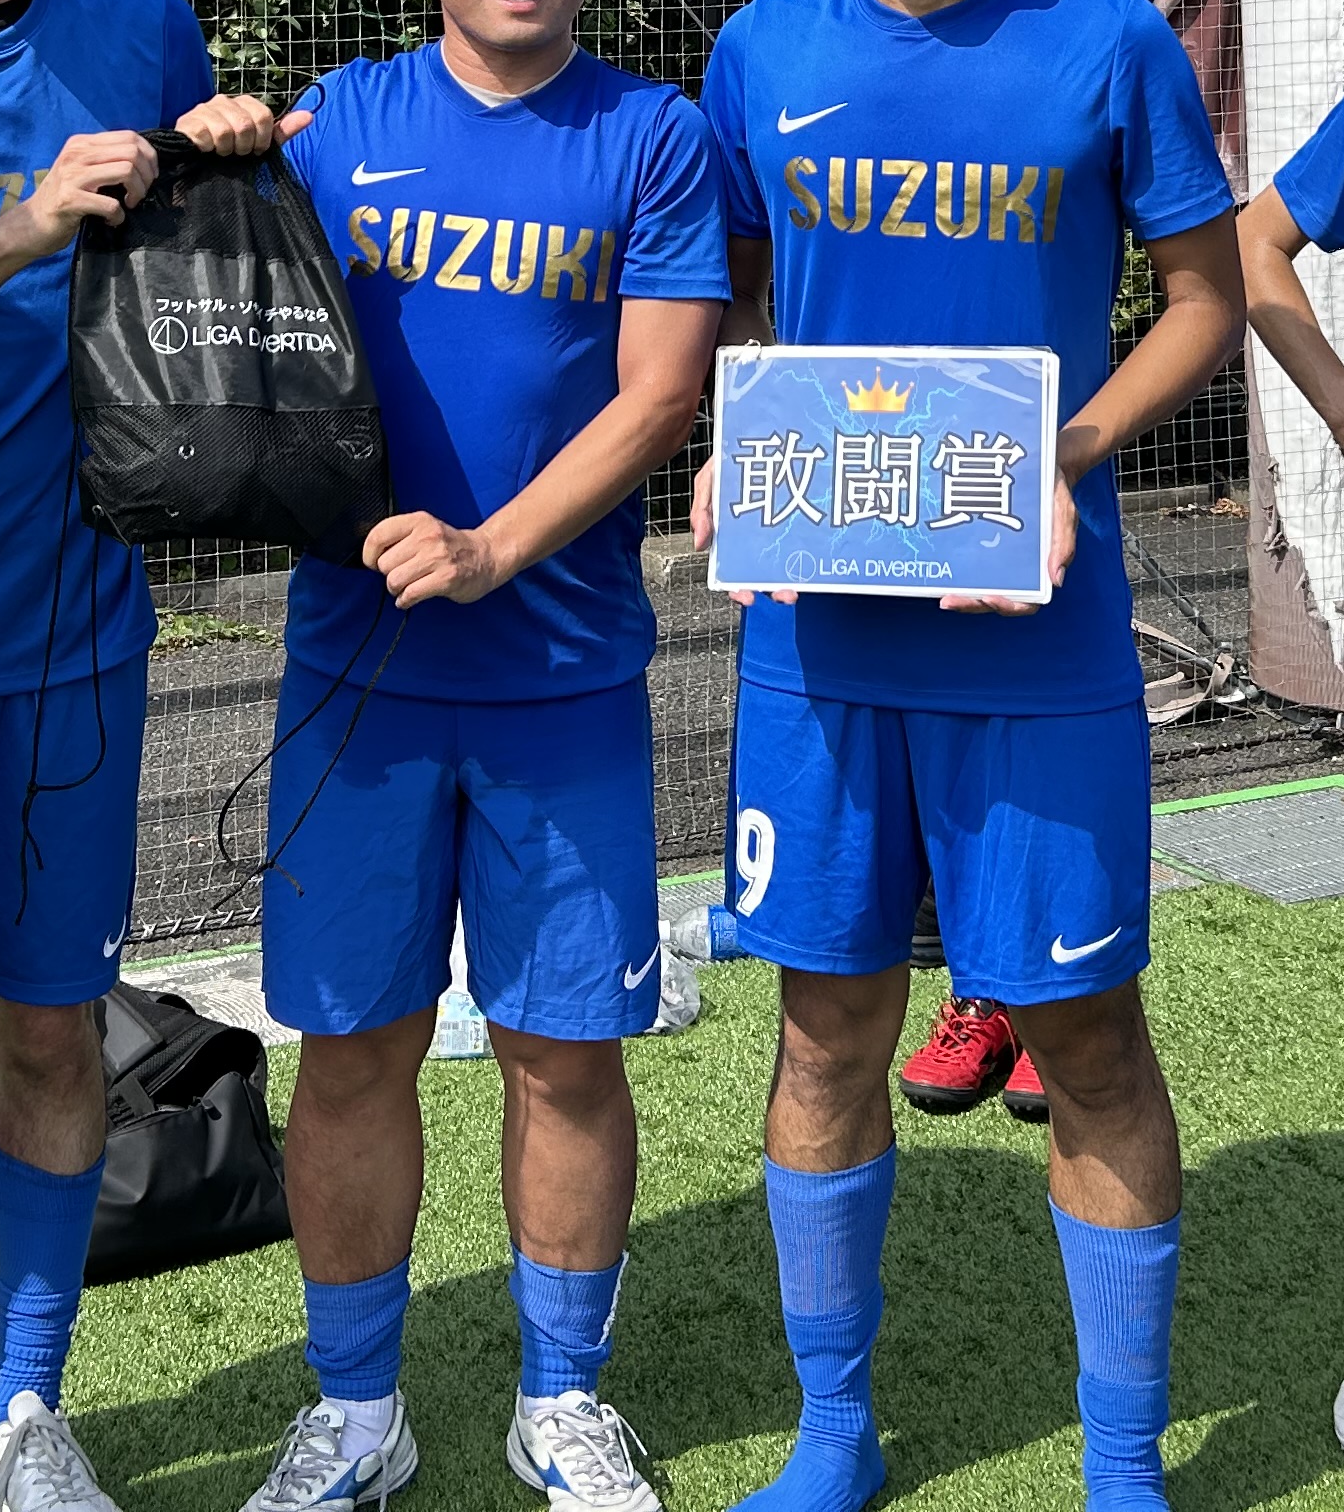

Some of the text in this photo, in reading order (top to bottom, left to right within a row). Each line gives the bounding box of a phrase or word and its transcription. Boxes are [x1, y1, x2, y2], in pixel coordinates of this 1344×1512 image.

[783, 155, 1065, 243] SUZUKI
[347, 204, 617, 303] SUZUKI
[729, 426, 1028, 533] 敢闘賞
